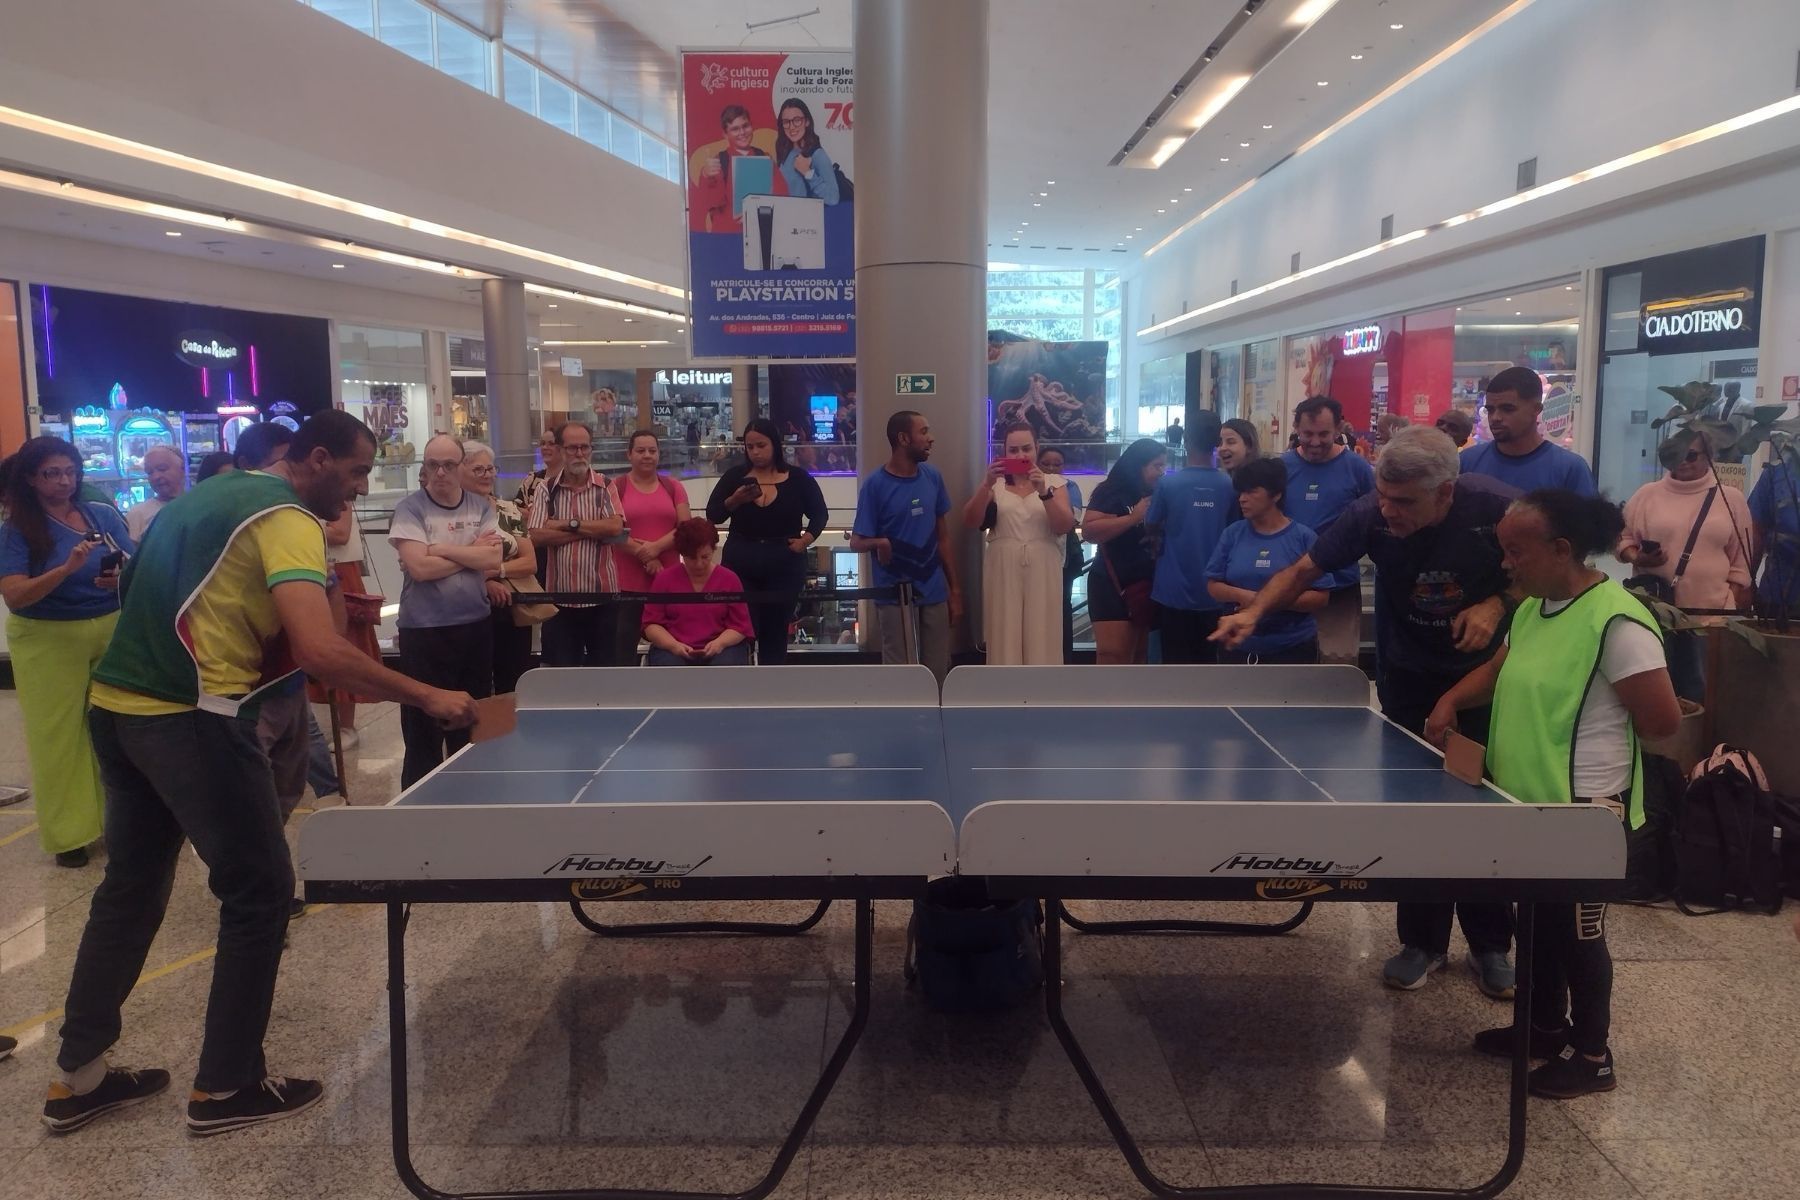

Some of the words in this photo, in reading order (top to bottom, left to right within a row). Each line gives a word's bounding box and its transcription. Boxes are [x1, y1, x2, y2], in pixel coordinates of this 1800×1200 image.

[730, 67, 768, 77] cultura
[786, 67, 823, 76] Cultura
[731, 78, 768, 90] inglesa
[793, 76, 814, 85] Juiz
[816, 76, 829, 85] de
[780, 85, 824, 94] inovando
[826, 86, 834, 94] o
[710, 279, 775, 288] MATRICULE-SE
[784, 279, 834, 287] CONCORRA
[836, 279, 844, 287] A
[716, 286, 838, 302] PLAYSTATION
[843, 286, 854, 301] 5
[721, 313, 734, 321] dos
[735, 313, 771, 322] Andradas,
[791, 313, 815, 321] Centro
[820, 313, 835, 321] Juiz
[835, 313, 846, 321] de
[181, 339, 202, 354] Casa
[672, 369, 733, 385] leitura
[559, 857, 666, 874] Hobby
[1226, 856, 1335, 874] Hobby
[654, 879, 681, 889] PRO
[1339, 879, 1368, 890] PRO
